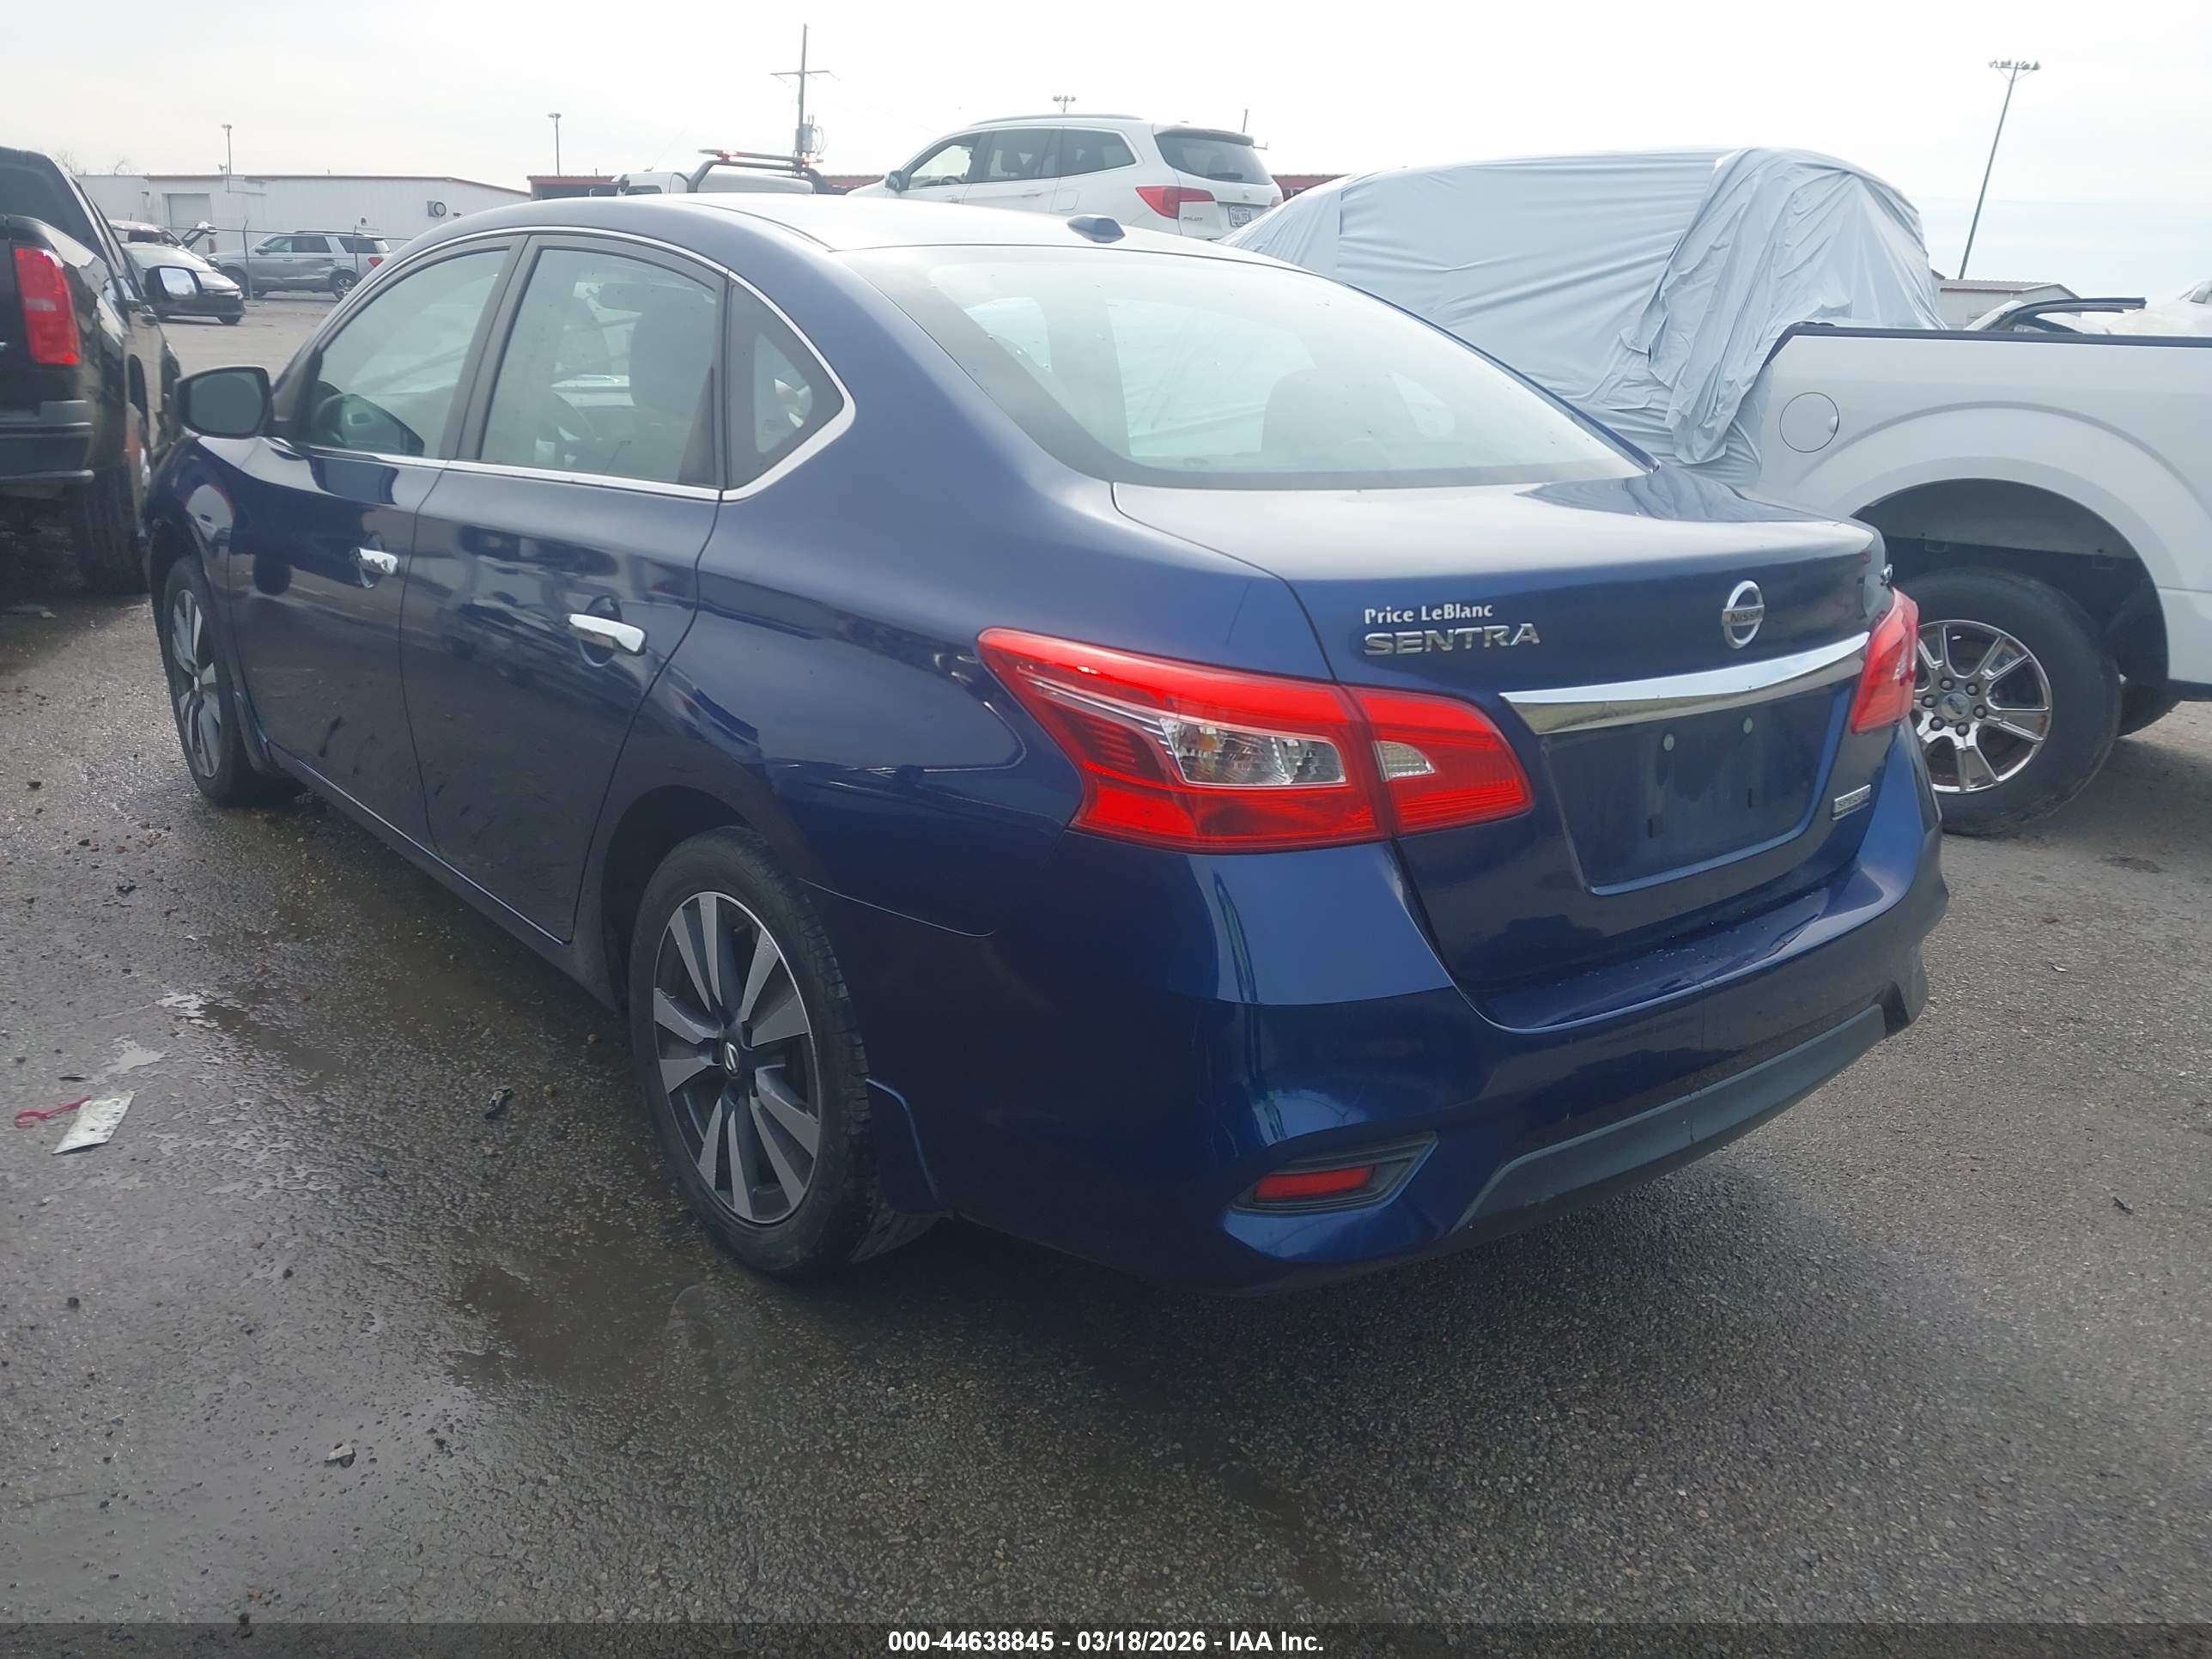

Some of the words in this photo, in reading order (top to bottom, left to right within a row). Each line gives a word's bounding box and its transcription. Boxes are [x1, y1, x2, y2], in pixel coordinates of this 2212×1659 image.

[1364, 606, 1413, 624] Price
[1421, 604, 1493, 621] LeBlanc
[1730, 607, 1763, 623] NISS
[1364, 623, 1540, 655] SENTRA
